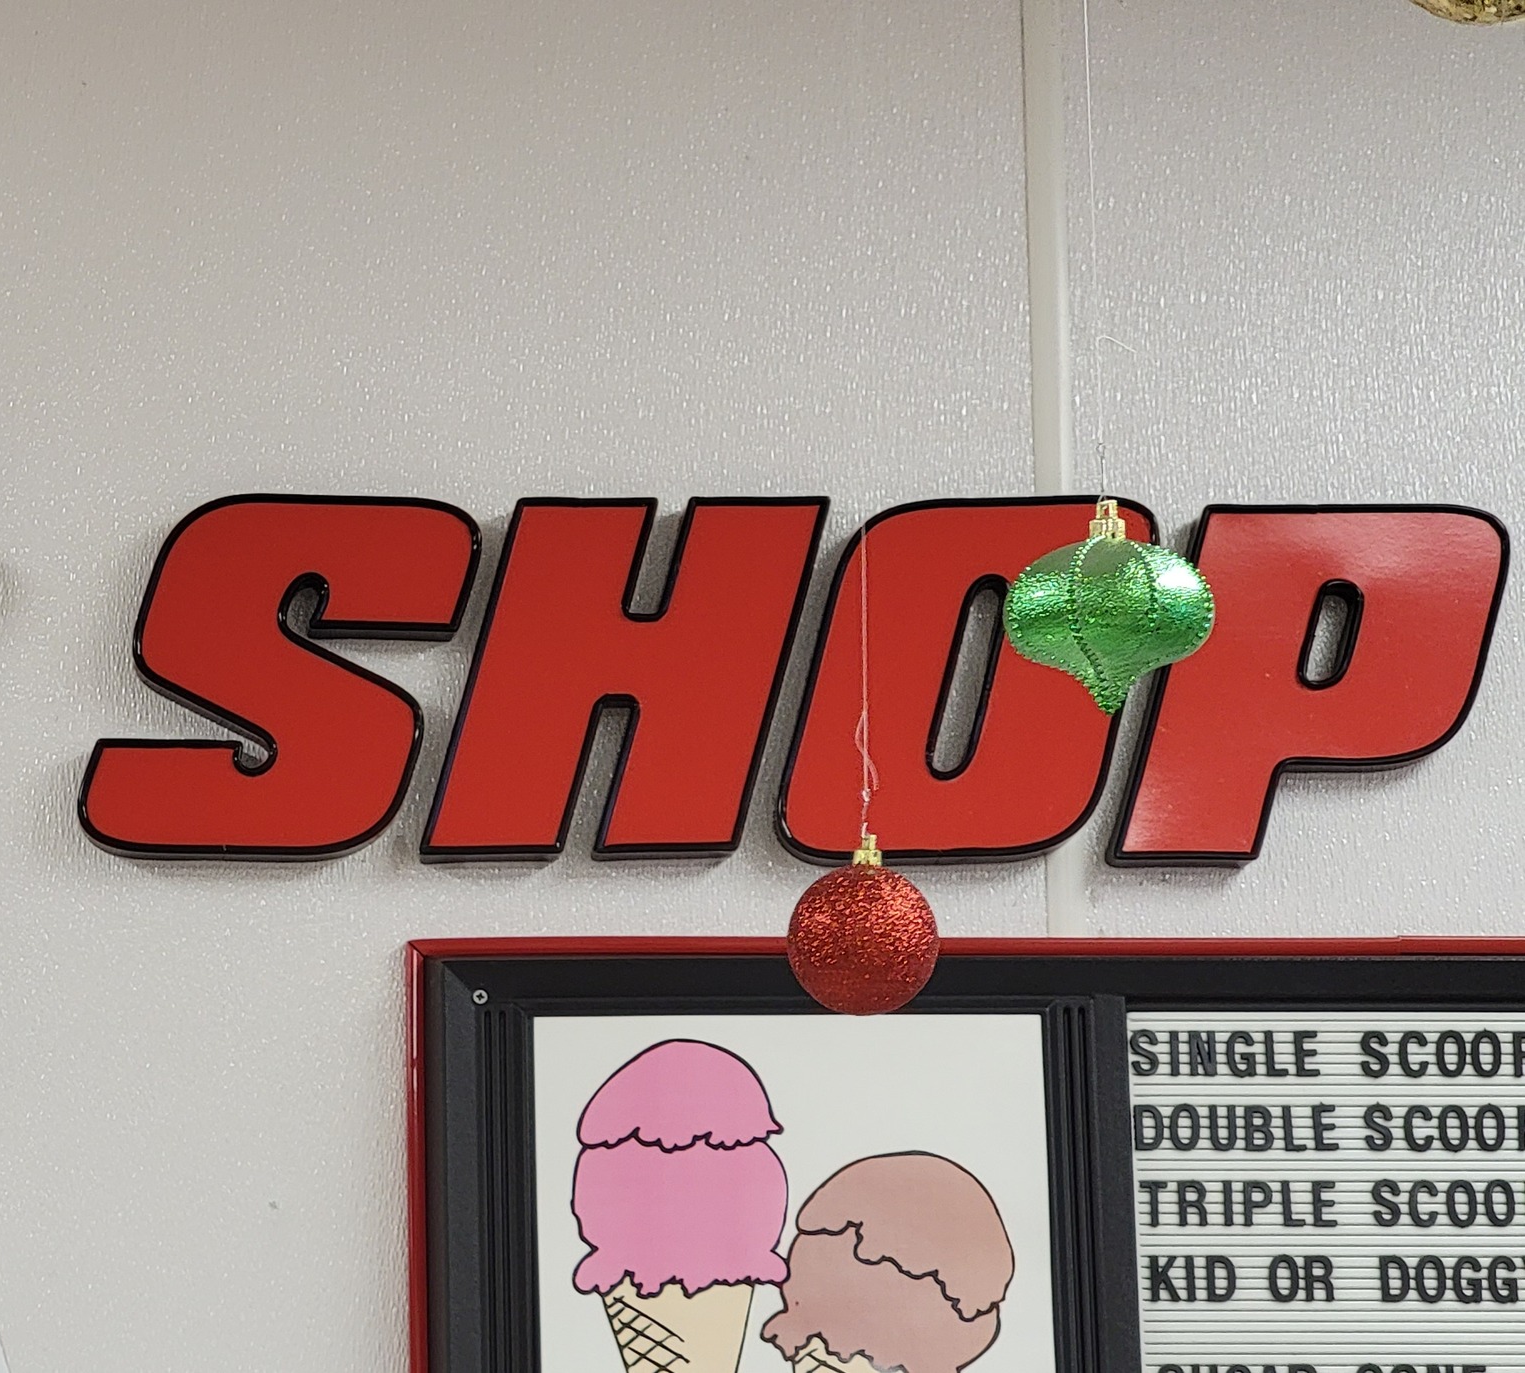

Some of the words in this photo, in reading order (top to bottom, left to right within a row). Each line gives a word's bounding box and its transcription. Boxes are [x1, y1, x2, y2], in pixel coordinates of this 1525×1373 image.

[79, 495, 1511, 867] SHOP
[1129, 1029, 1320, 1077] SINGLE
[1133, 1103, 1339, 1151] DOUBLE
[1363, 1102, 1525, 1152] SCOO
[1139, 1180, 1337, 1227] TRIPLE
[1372, 1179, 1525, 1228] SCOO
[1147, 1255, 1236, 1302] KID
[1269, 1254, 1335, 1302] OR
[1379, 1255, 1525, 1303] DOGG
